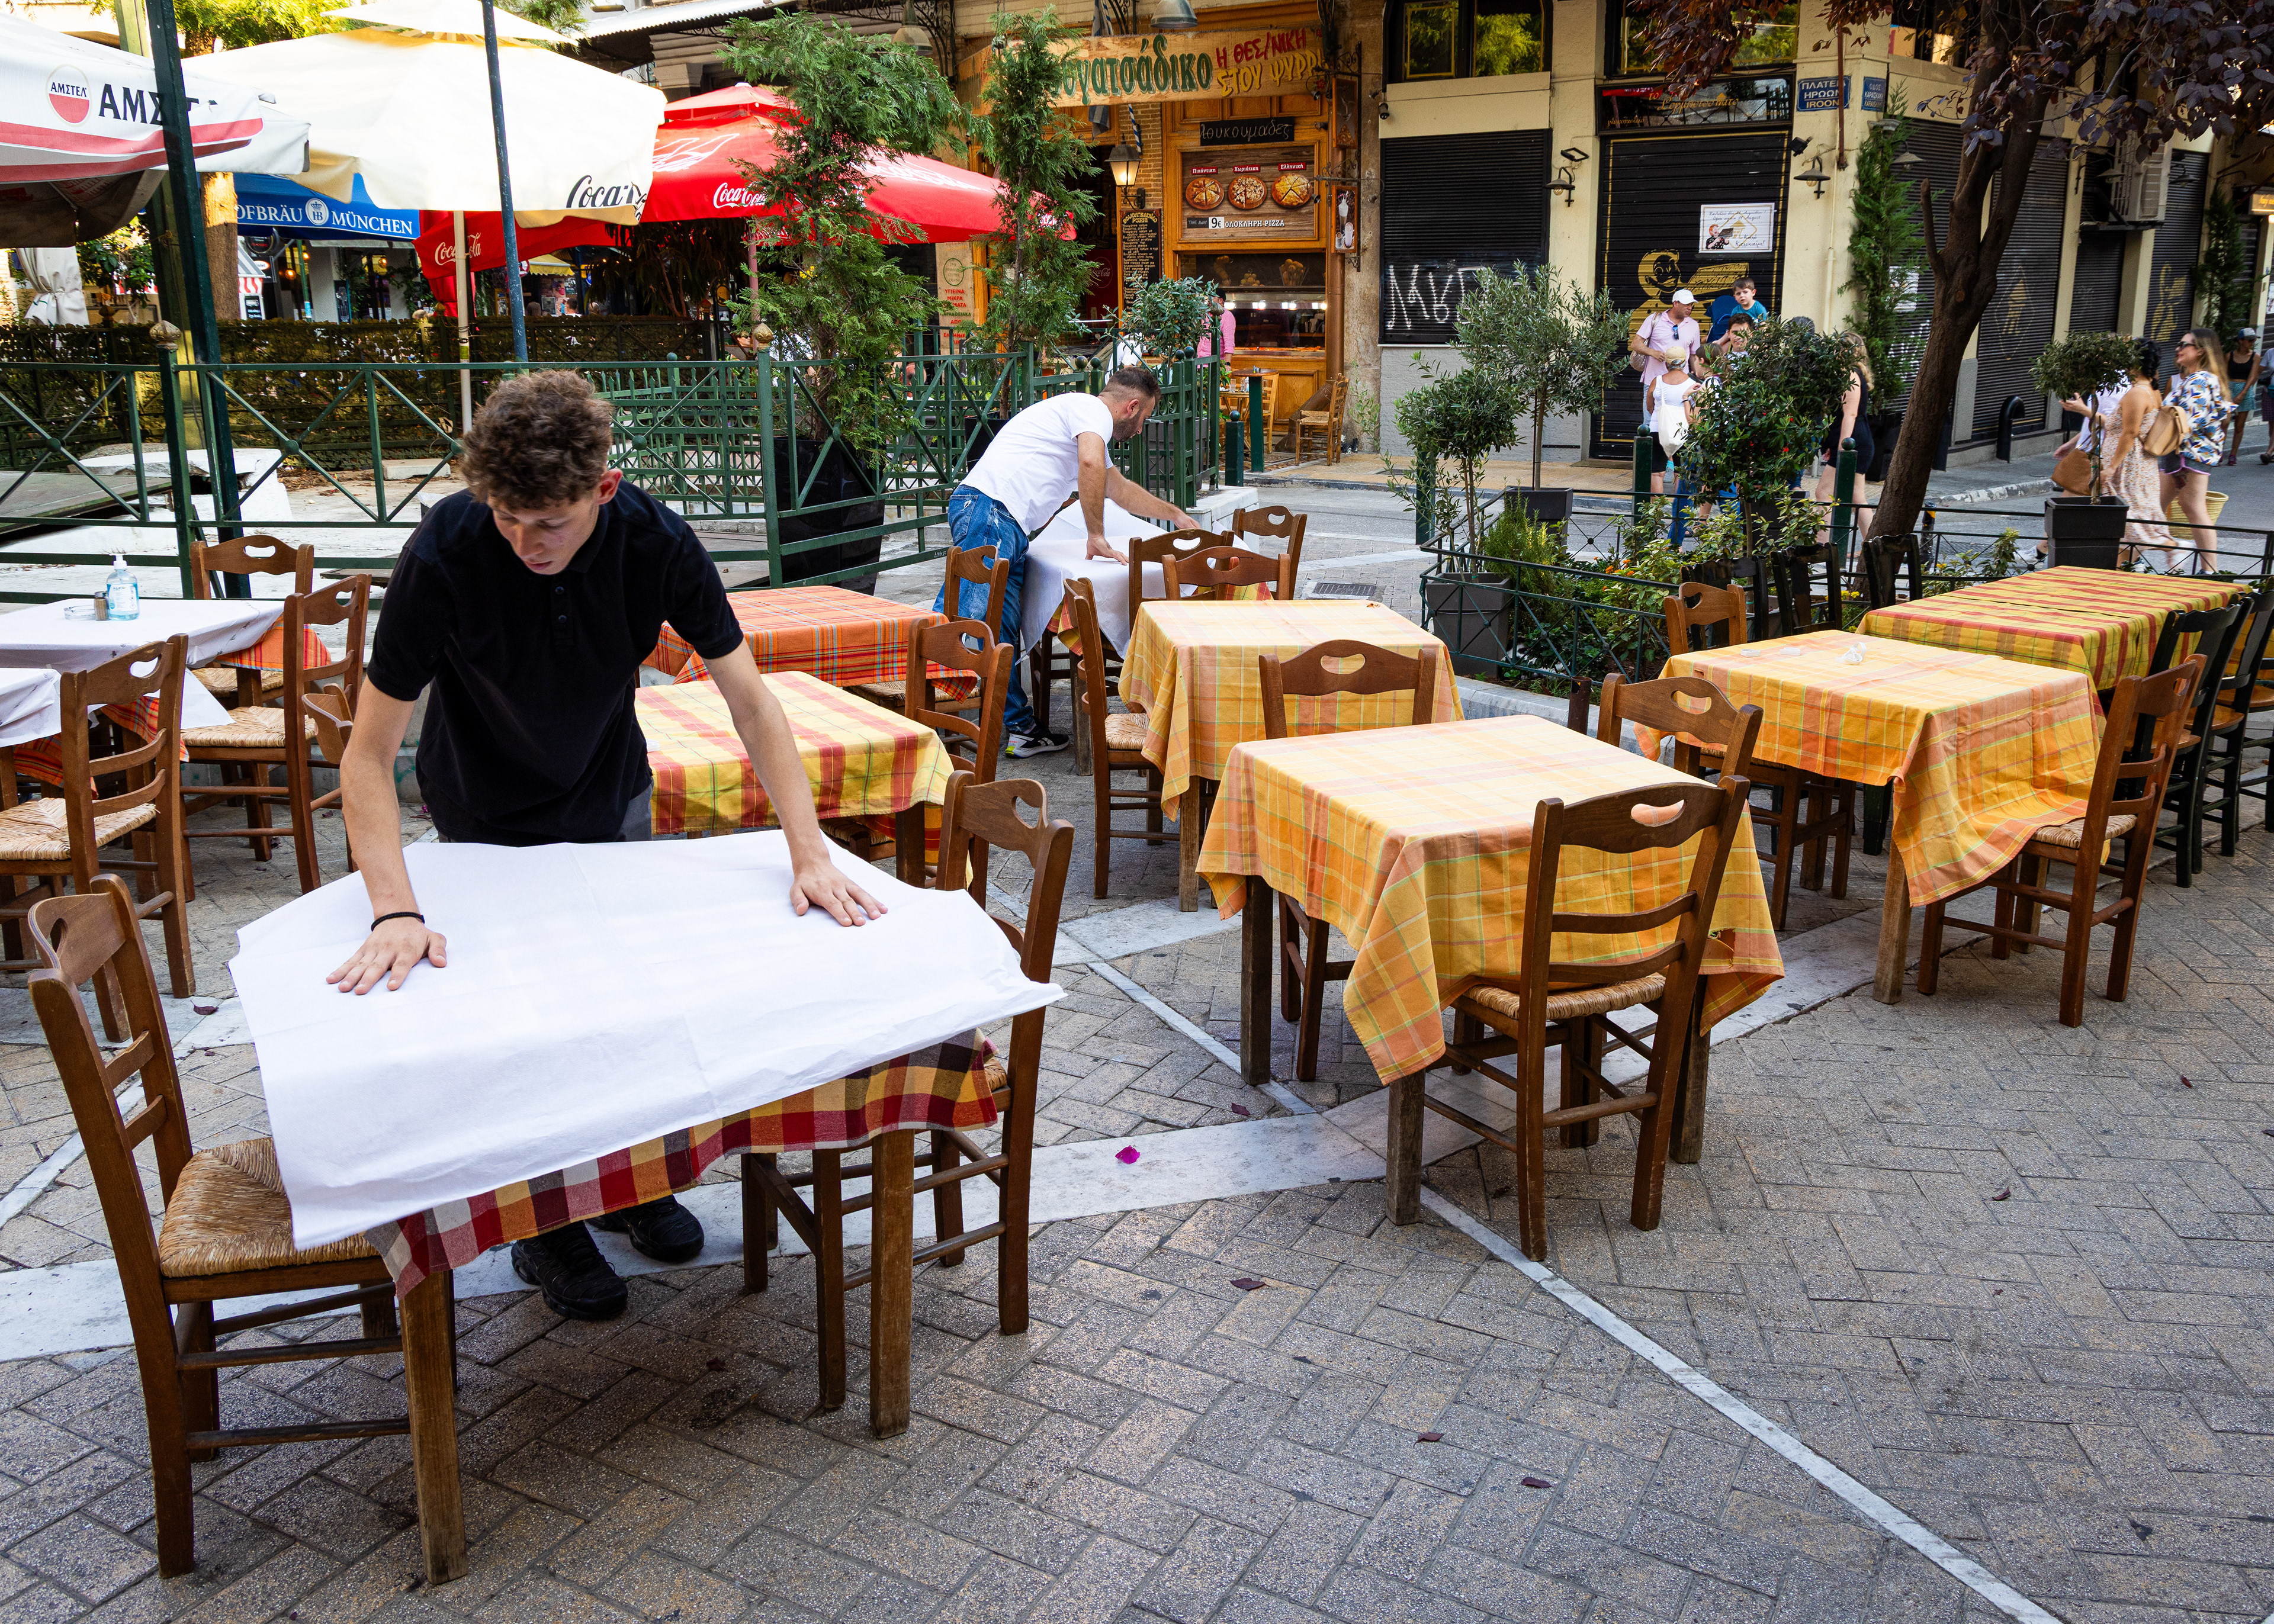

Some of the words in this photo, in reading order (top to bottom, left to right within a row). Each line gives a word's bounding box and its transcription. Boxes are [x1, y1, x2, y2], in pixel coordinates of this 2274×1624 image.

[1216, 47, 1227, 68] Η
[1234, 28, 1305, 63] ΘΕΣ/ΝΙΚΗ
[1045, 36, 1214, 105] υγατσάδικο
[1217, 63, 1262, 97] ΣΤΟΥ
[51, 82, 87, 97] ΑΜΣΤΕΛ
[237, 204, 303, 223] OFBRÄU
[332, 210, 413, 235] MÜNCHEN
[1211, 217, 1222, 228] 9€
